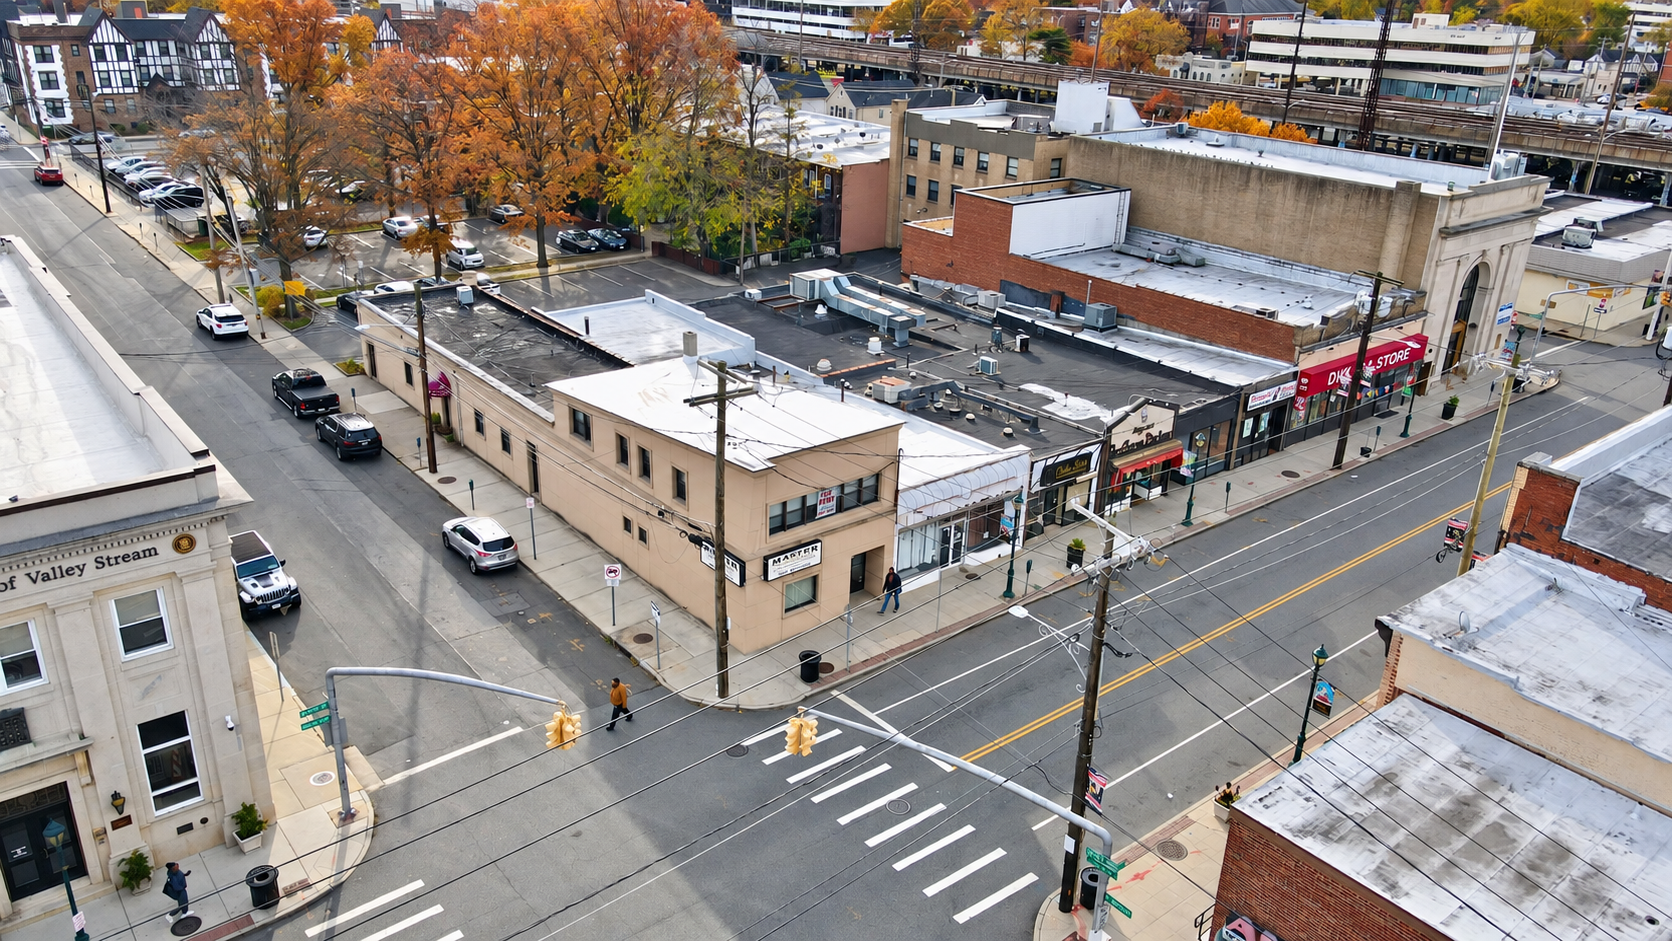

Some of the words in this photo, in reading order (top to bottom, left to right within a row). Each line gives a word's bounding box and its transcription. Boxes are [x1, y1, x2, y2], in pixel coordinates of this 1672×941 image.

[1375, 347, 1411, 369] STORE
[772, 545, 818, 567] MASTER
[0, 576, 17, 593] of
[25, 563, 87, 585] Valley
[94, 546, 159, 570] Stream
